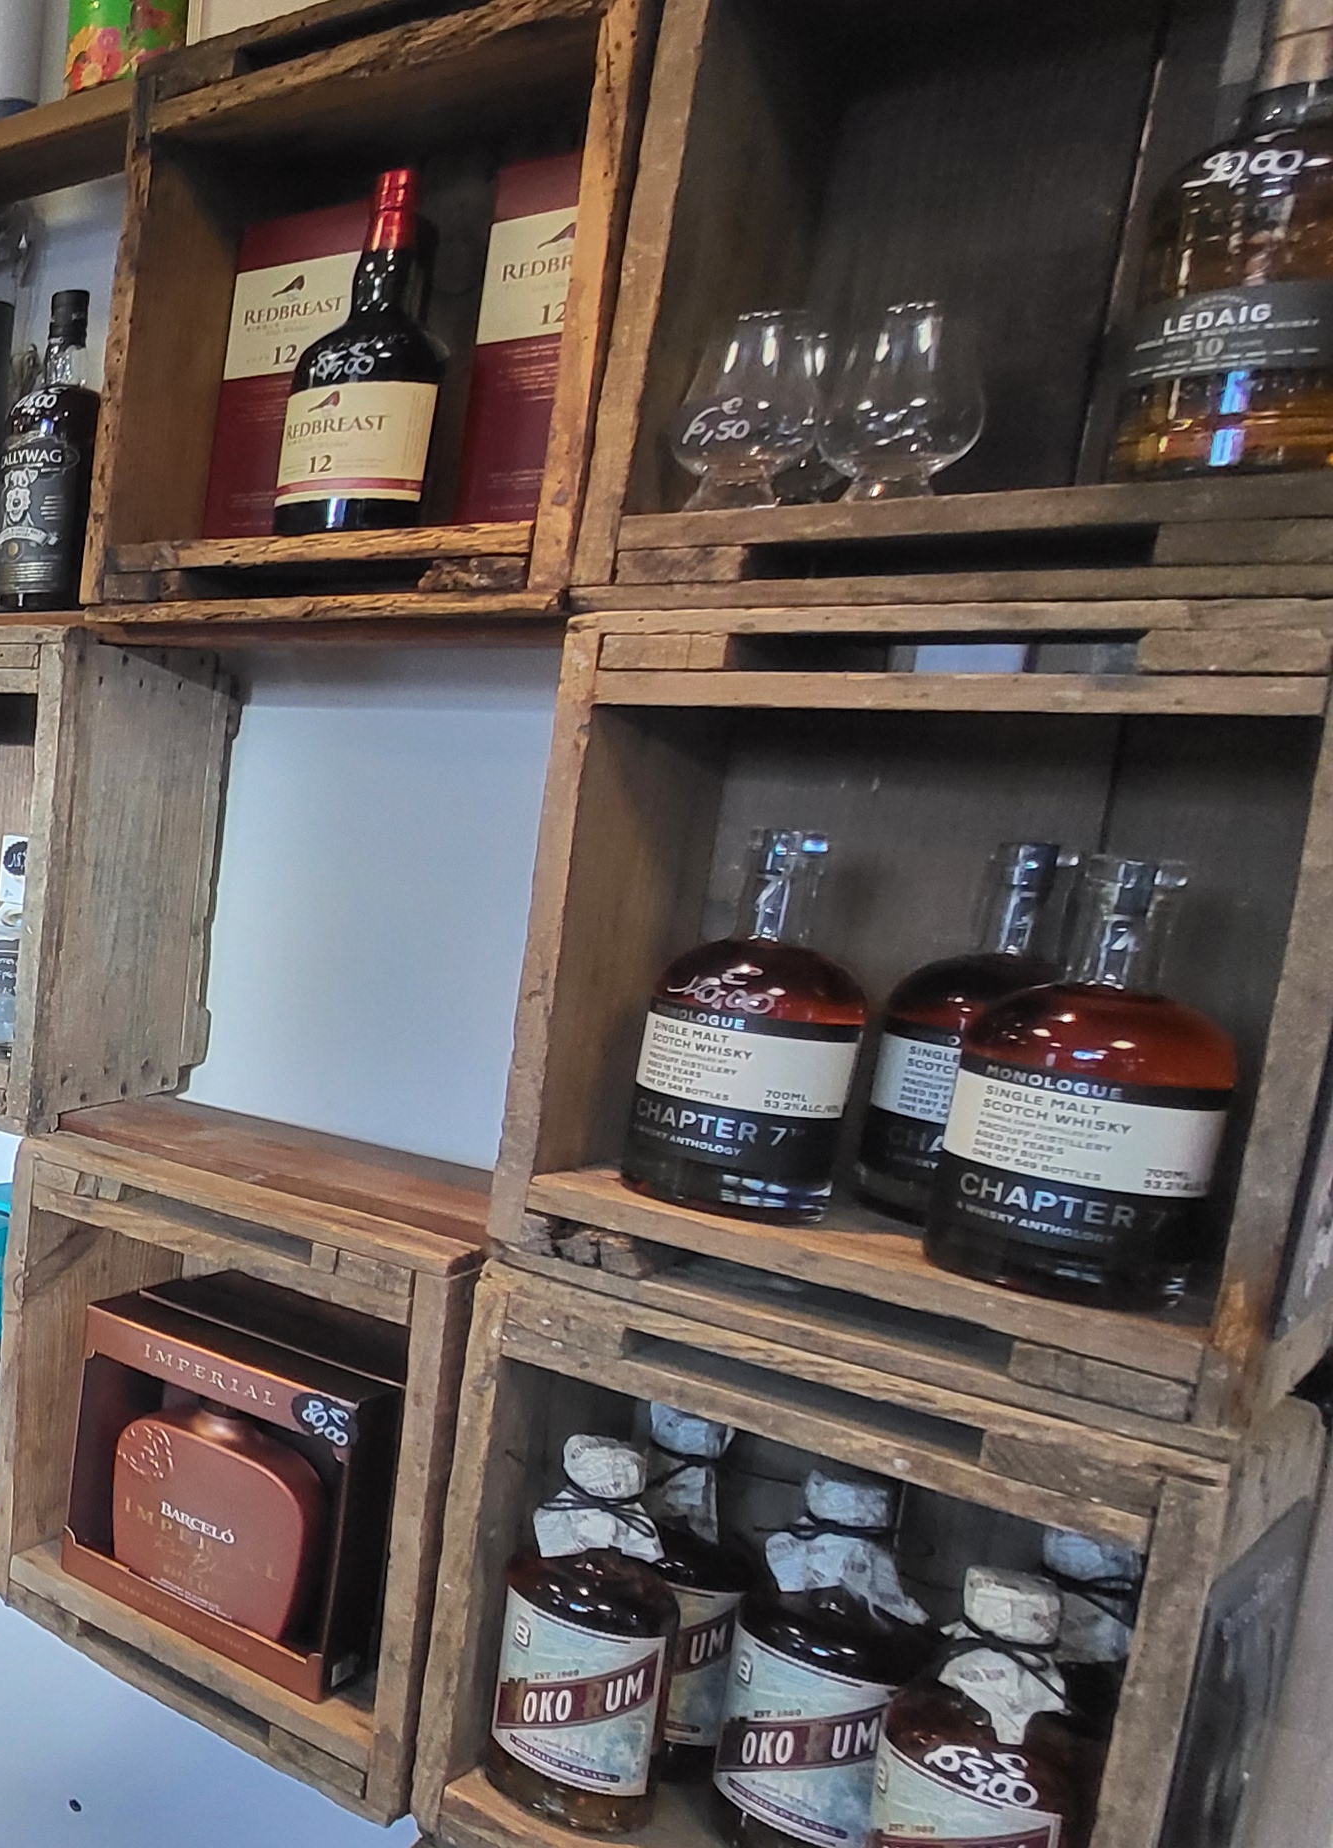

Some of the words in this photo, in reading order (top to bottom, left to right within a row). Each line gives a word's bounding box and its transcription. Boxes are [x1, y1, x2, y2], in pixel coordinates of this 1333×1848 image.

[243, 296, 348, 326] REDBREAST
[540, 301, 566, 325] 12
[1163, 303, 1272, 336] LEDAIG
[272, 344, 298, 366] 12
[1193, 338, 1224, 357] 10
[286, 415, 390, 441] REDBREAST
[308, 455, 332, 474] 12
[654, 1020, 688, 1037] SINGLE
[692, 1030, 730, 1044] MALT
[652, 1032, 691, 1049] SCOTCH
[695, 1043, 753, 1061] WHISKY
[909, 1045, 961, 1064] SINGLE
[672, 1073, 694, 1086] BUTT
[673, 1066, 701, 1078] YEARS
[985, 1063, 1123, 1100] MONOLOGUE
[685, 1085, 729, 1102] BOTTLES
[765, 1089, 808, 1103] 700ML
[985, 1085, 1043, 1106] SINGLE
[1049, 1098, 1103, 1116] MALT
[636, 1097, 759, 1144] CHAPTER
[983, 1098, 1048, 1121] SCOTCH
[1054, 1113, 1132, 1135] WHISKY
[669, 1135, 742, 1157] ANTHOLOGY
[975, 1128, 1004, 1144] AGED
[1022, 1139, 1065, 1156] YEARS
[978, 1119, 1032, 1139] MACDUFF
[1034, 1131, 1113, 1153] DISTILLERY
[995, 1153, 1012, 1164] OF
[1041, 1162, 1102, 1182] BOTTLES
[1019, 1148, 1054, 1163] BUTT
[959, 1172, 1136, 1230] CHAPTER
[965, 1203, 1015, 1224] WHISKY
[1017, 1217, 1115, 1244] ANTHOLOGY
[143, 1343, 277, 1407] IMPERIAL
[160, 1500, 236, 1545] BARCELÓ
